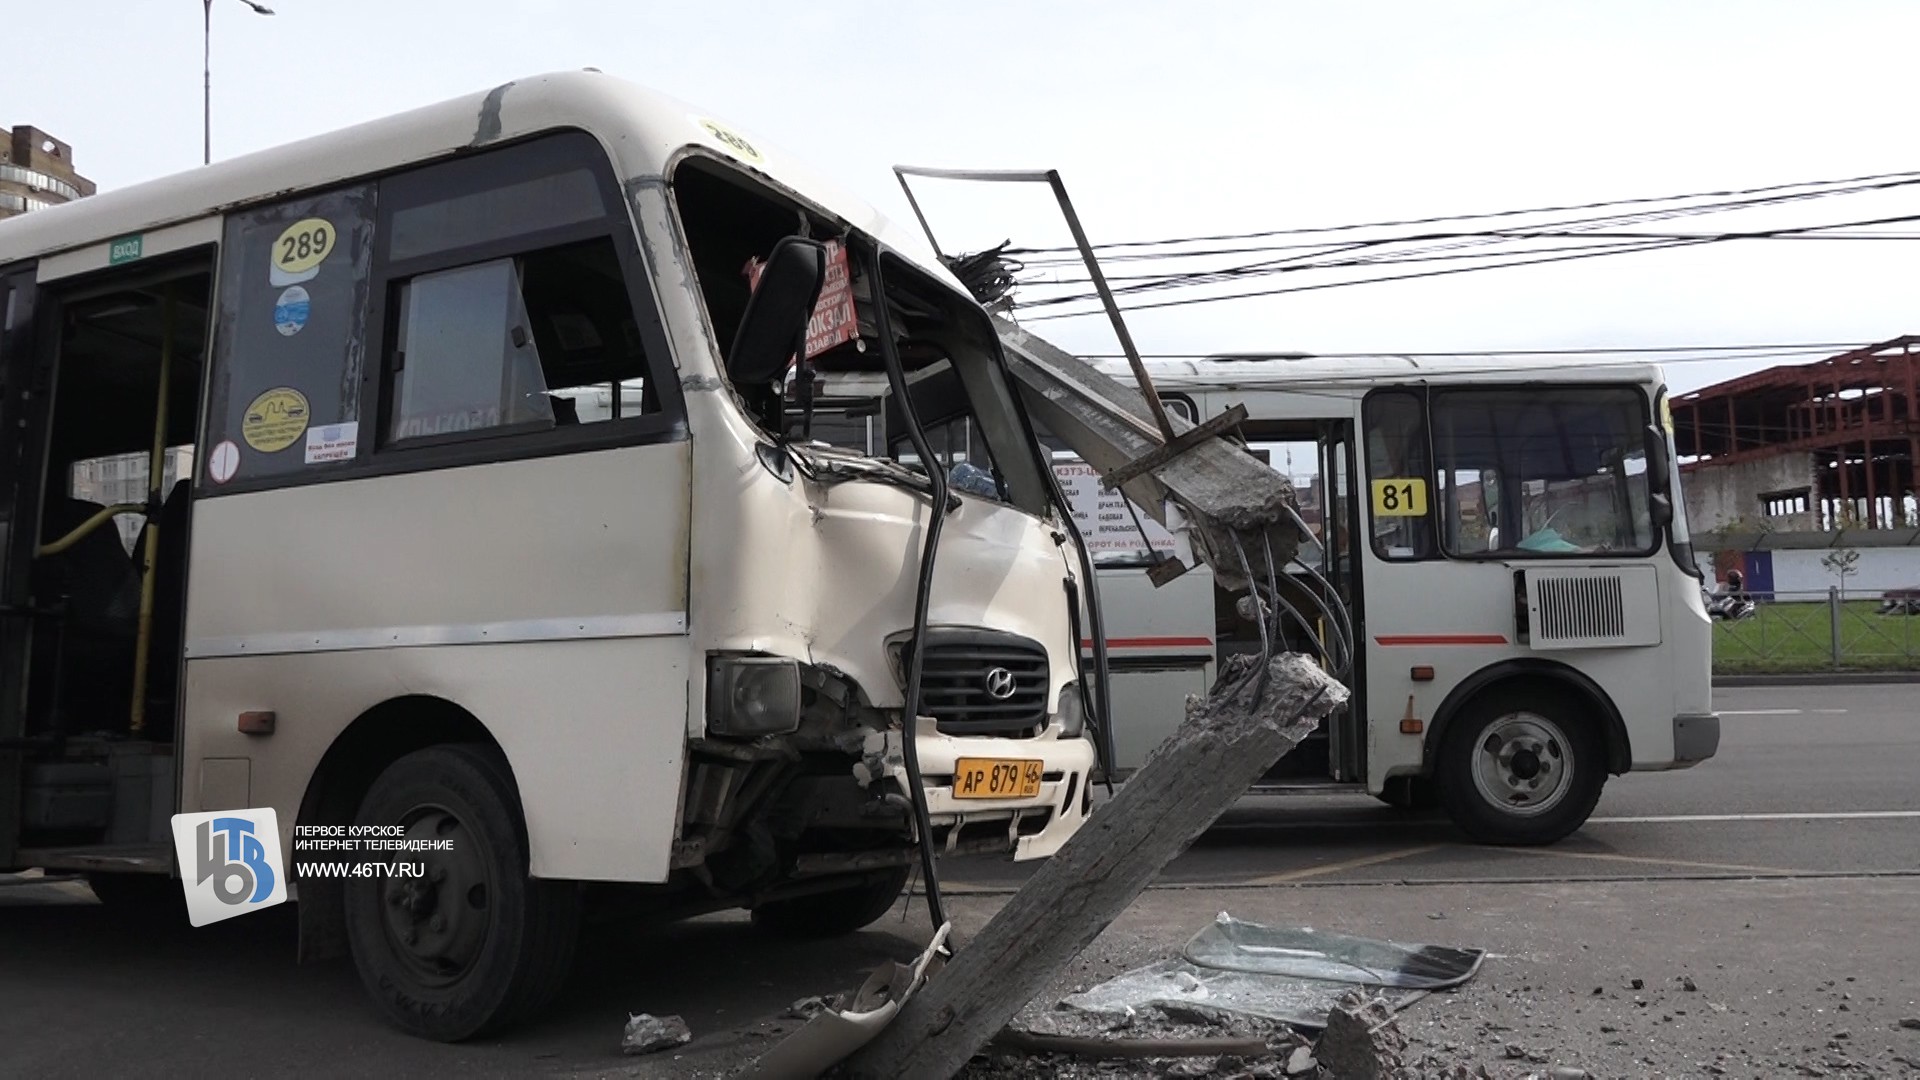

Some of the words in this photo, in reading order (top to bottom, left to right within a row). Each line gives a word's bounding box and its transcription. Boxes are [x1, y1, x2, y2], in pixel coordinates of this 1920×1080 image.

[113, 241, 139, 260] ВХОД
[281, 227, 327, 264] 289
[805, 330, 843, 354] ОЗАВОД
[1383, 484, 1413, 510] 81
[989, 764, 1018, 793] 879
[1025, 763, 1039, 784] 46
